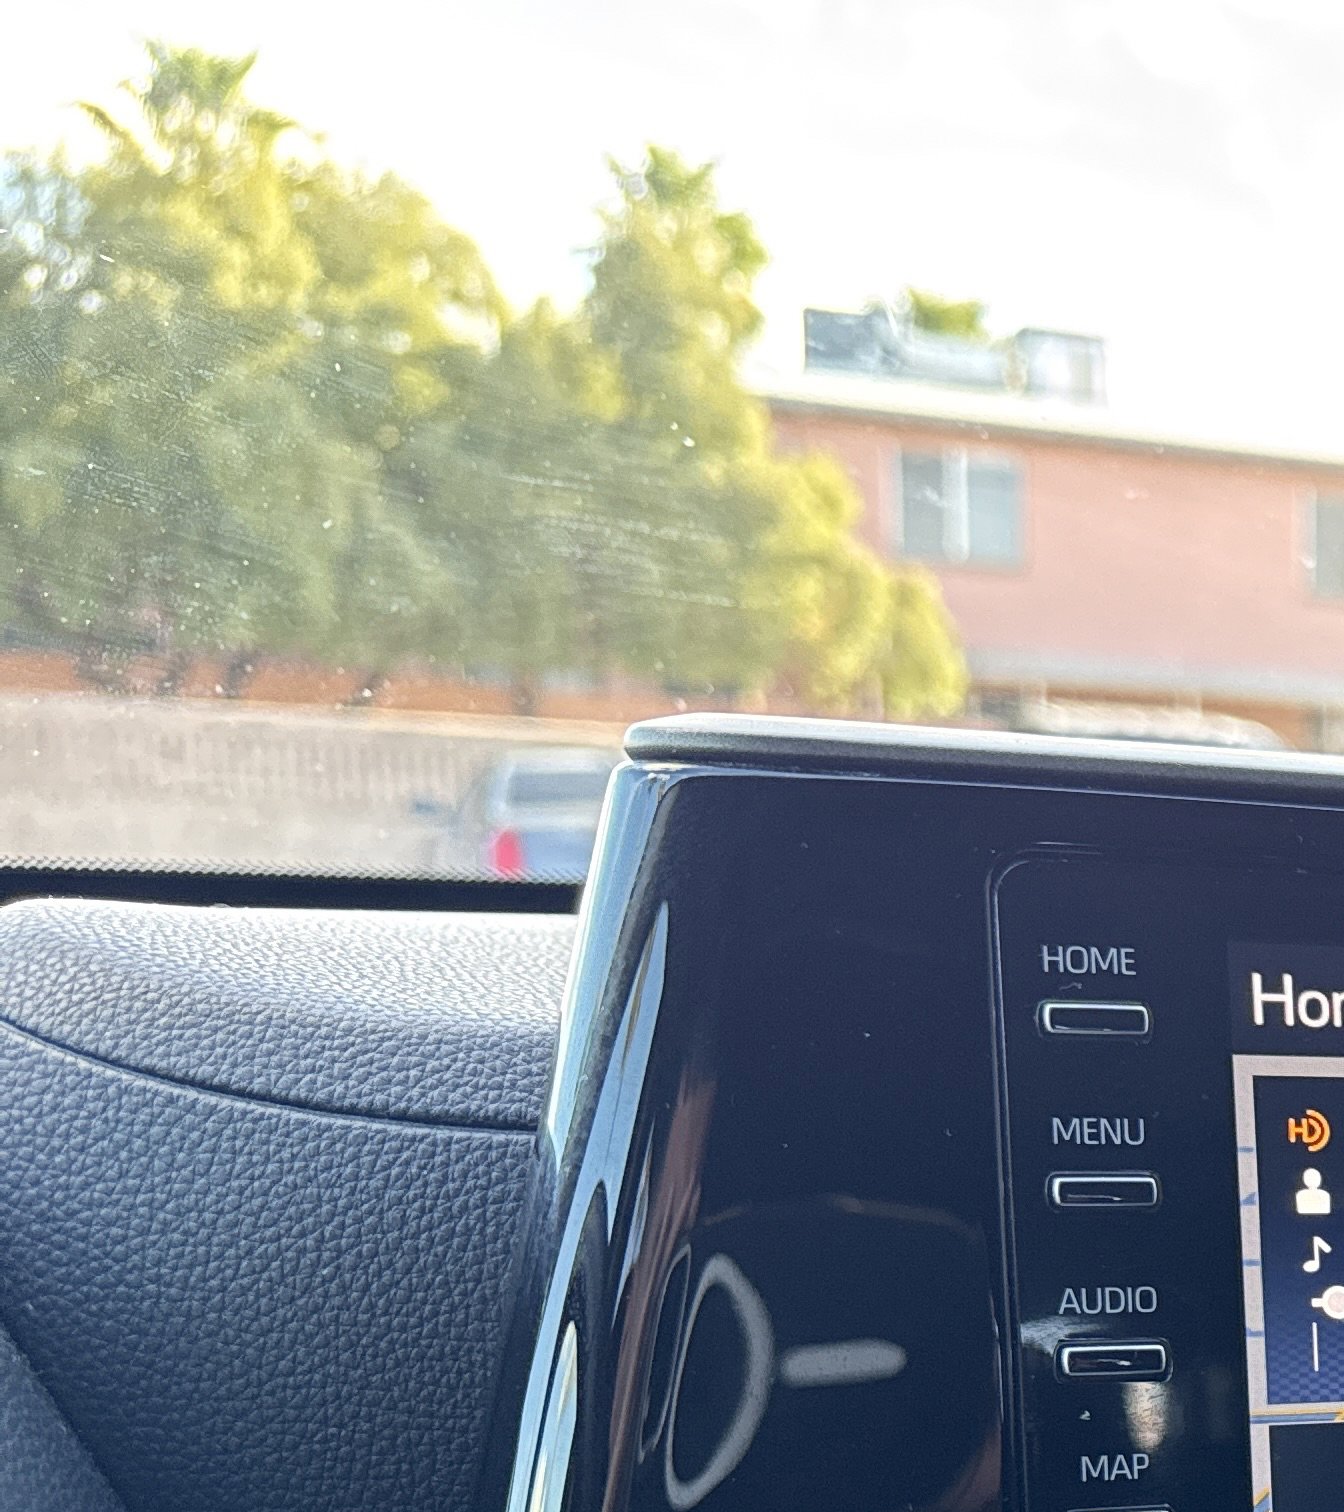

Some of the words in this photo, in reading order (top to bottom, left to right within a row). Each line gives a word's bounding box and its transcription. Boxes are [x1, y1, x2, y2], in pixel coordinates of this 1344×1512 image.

[1041, 945, 1137, 977] HOME
[1052, 1117, 1146, 1147] MENU
[1058, 1286, 1158, 1315] AUDIO
[1080, 1453, 1151, 1483] MAP
